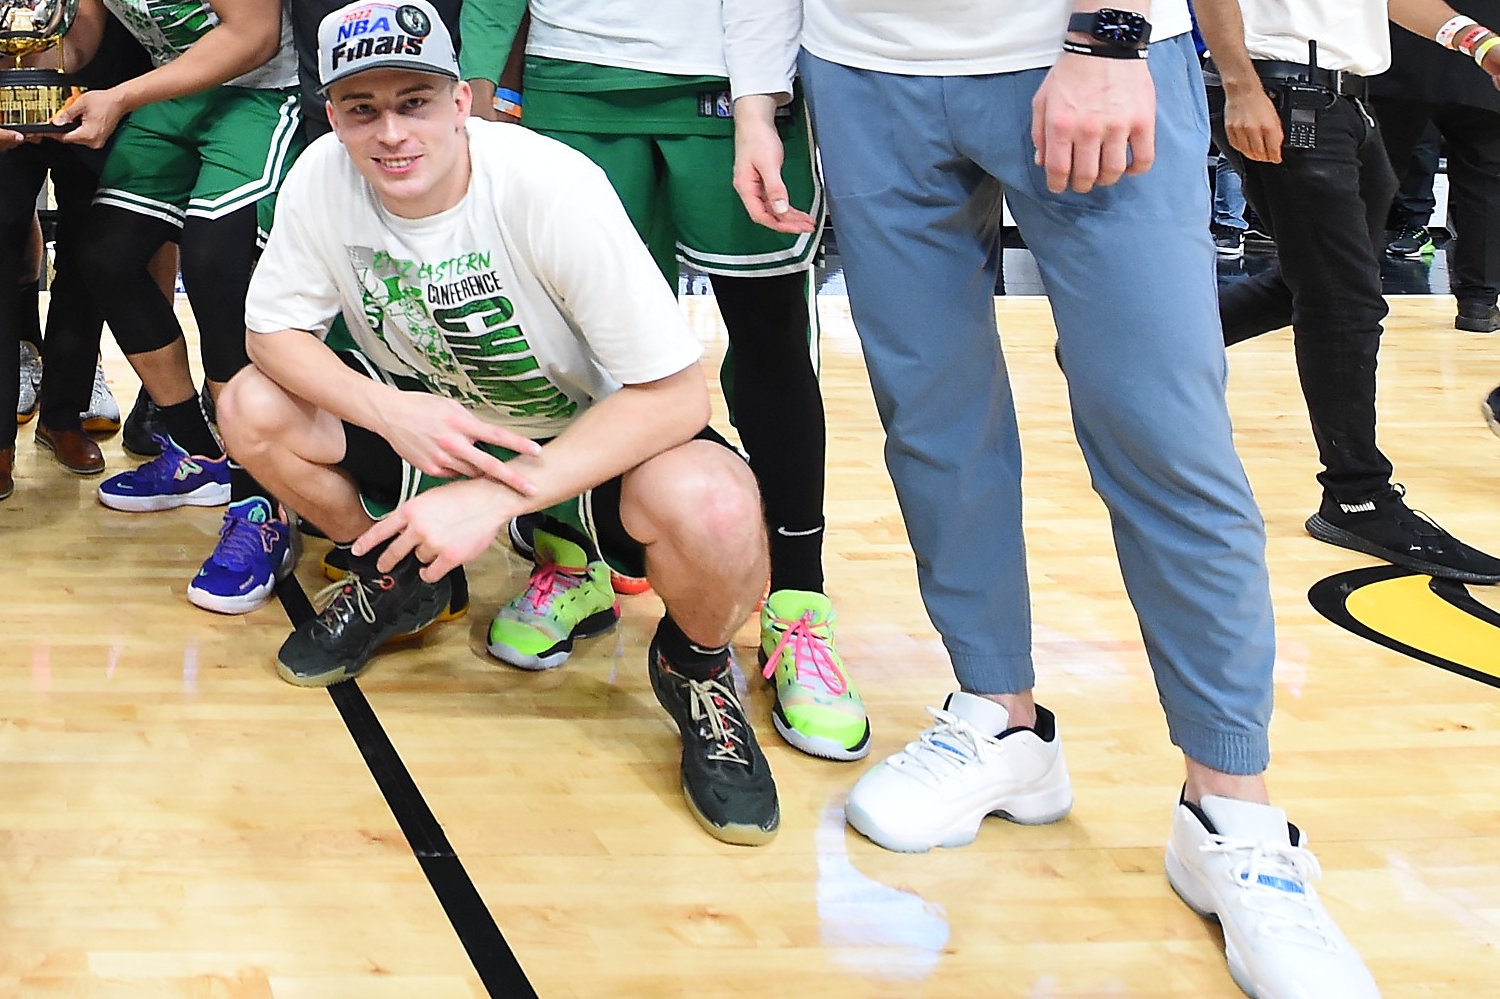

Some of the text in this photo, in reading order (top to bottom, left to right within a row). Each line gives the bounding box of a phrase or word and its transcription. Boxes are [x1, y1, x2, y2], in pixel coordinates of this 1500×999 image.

[337, 17, 390, 43] NBA
[332, 35, 424, 71] Finals
[417, 251, 492, 283] EASTERN
[427, 271, 504, 305] CONFERENCE
